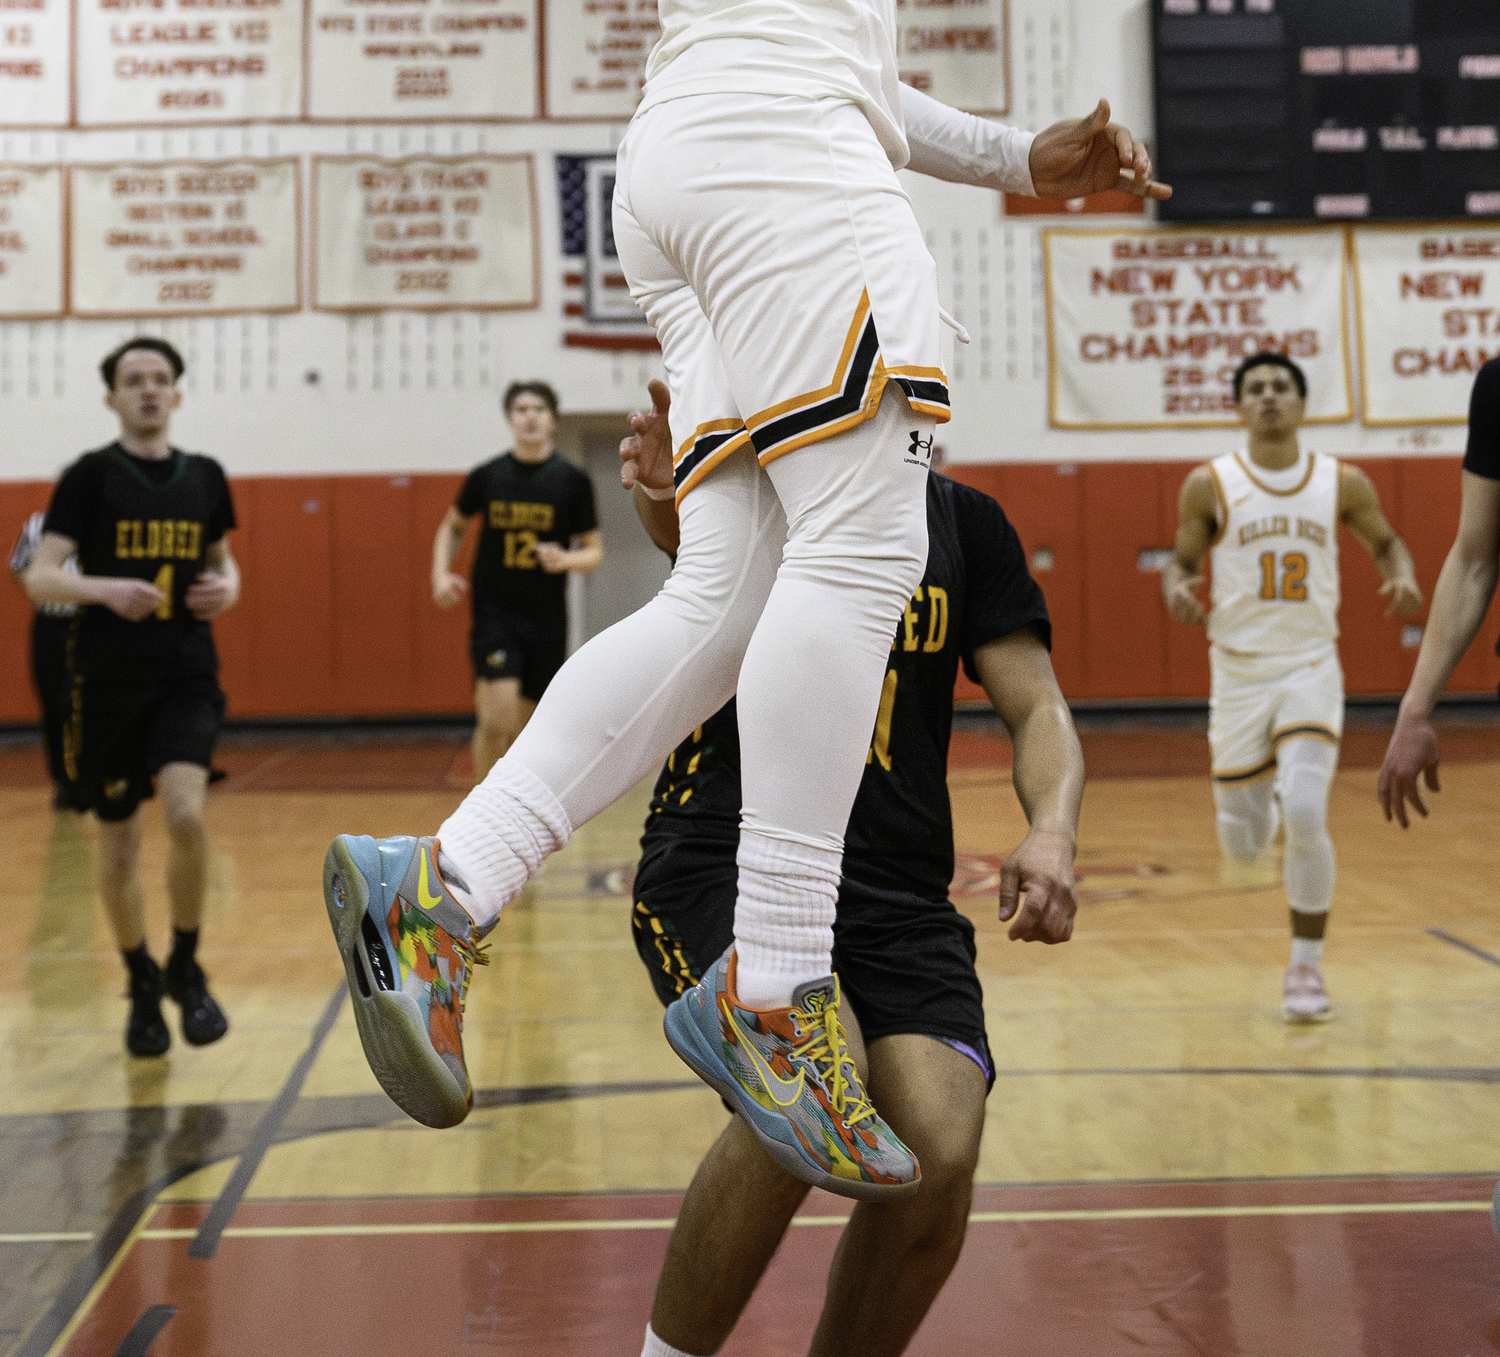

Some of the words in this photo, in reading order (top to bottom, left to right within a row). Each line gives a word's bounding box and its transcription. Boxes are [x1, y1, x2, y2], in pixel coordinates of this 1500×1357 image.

[110, 21, 217, 45] LEAGUE
[114, 55, 266, 78] CHAMPIONS
[126, 254, 243, 273] CHAMPIONS
[364, 246, 481, 265] CHAMPIONS
[1112, 239, 1278, 261] BASEBALL
[1091, 267, 1177, 294] NEW
[1192, 264, 1302, 292] YORK
[1399, 271, 1484, 300] NEW
[1130, 298, 1266, 328] STATE
[1079, 330, 1320, 362] CHAMPIONS
[489, 500, 556, 531] ELDRED
[115, 519, 204, 560] ELDRED
[503, 532, 543, 569] 12
[1259, 551, 1309, 601] 12
